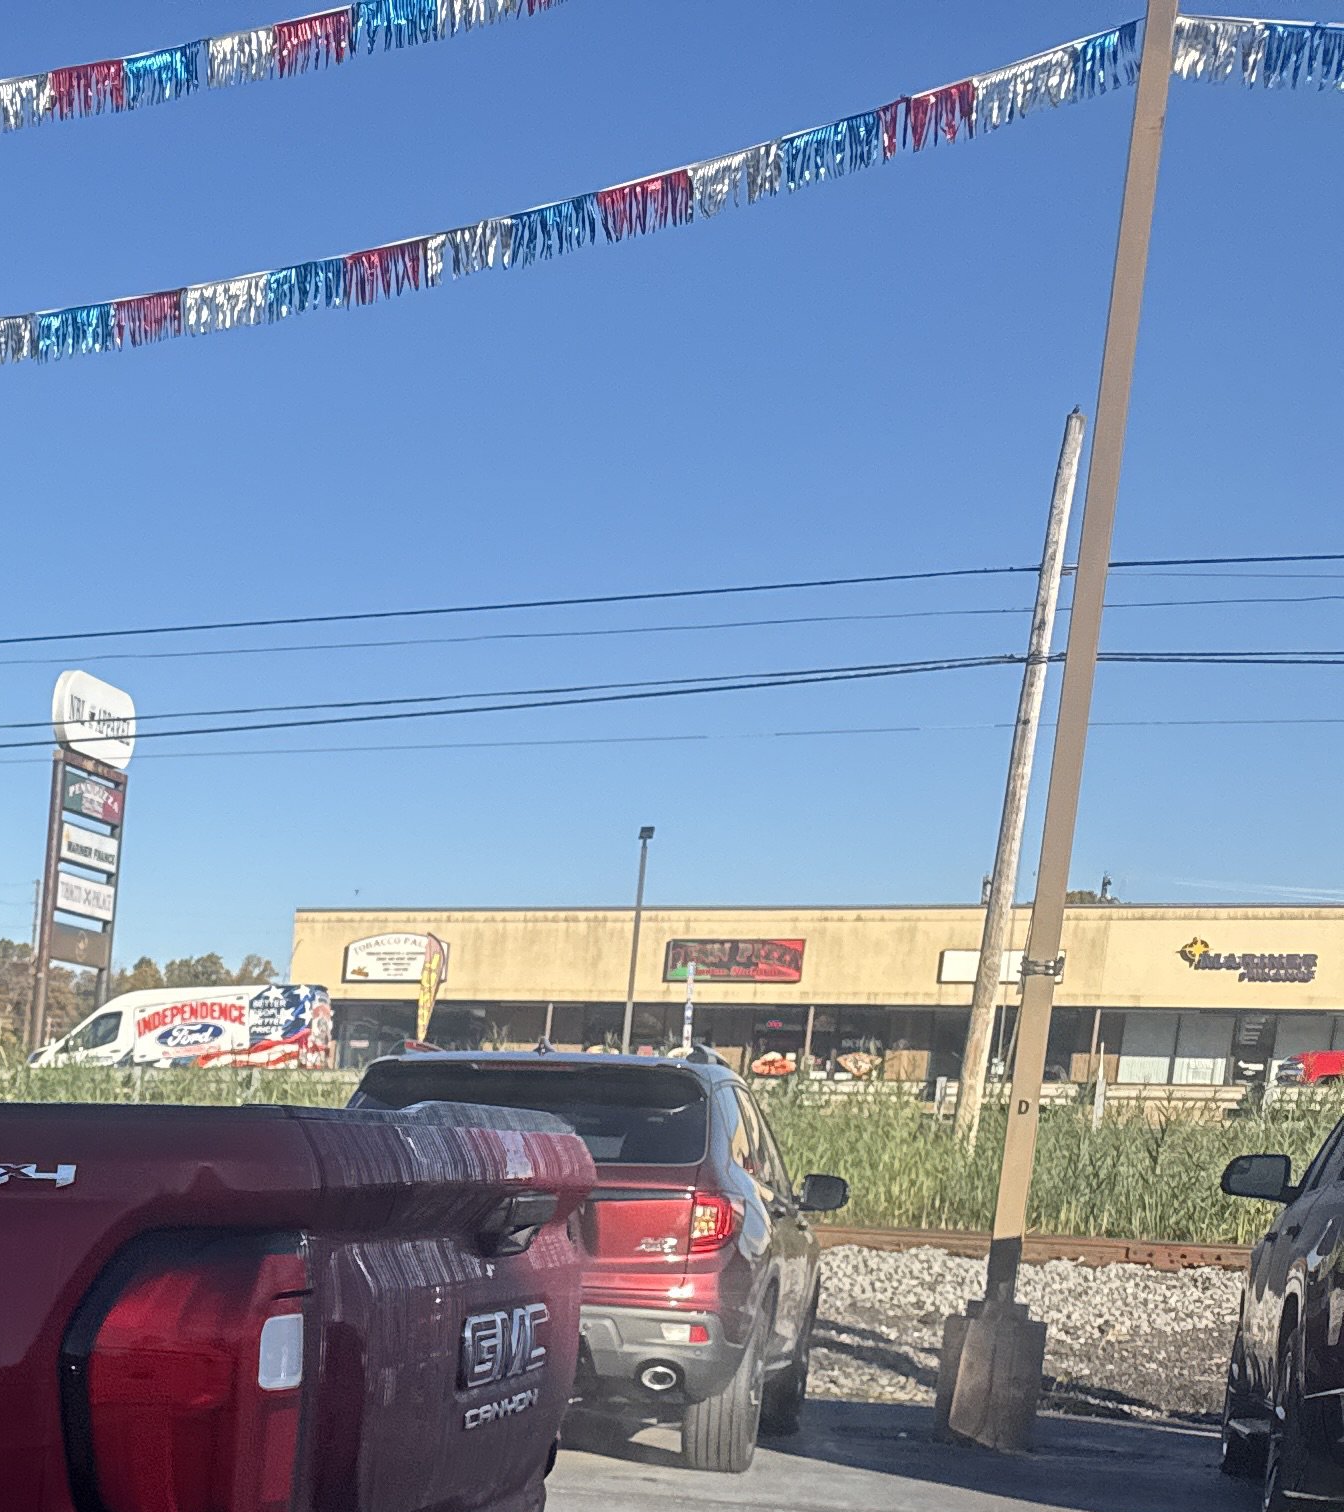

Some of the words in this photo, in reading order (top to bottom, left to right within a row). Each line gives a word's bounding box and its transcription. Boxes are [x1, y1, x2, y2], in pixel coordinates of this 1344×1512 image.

[68, 782, 92, 797] PENN
[94, 785, 119, 813] PIZZA
[353, 938, 401, 955] TOBACCO
[403, 937, 424, 948] PAL
[1194, 953, 1318, 970] MARINER
[252, 1000, 287, 1008] BETTER
[137, 1001, 246, 1038] INDEPENDENCE
[167, 1023, 214, 1047] Ford
[1018, 1100, 1029, 1115] D
[462, 1302, 549, 1388] GMC
[464, 1388, 539, 1430] CANYON
